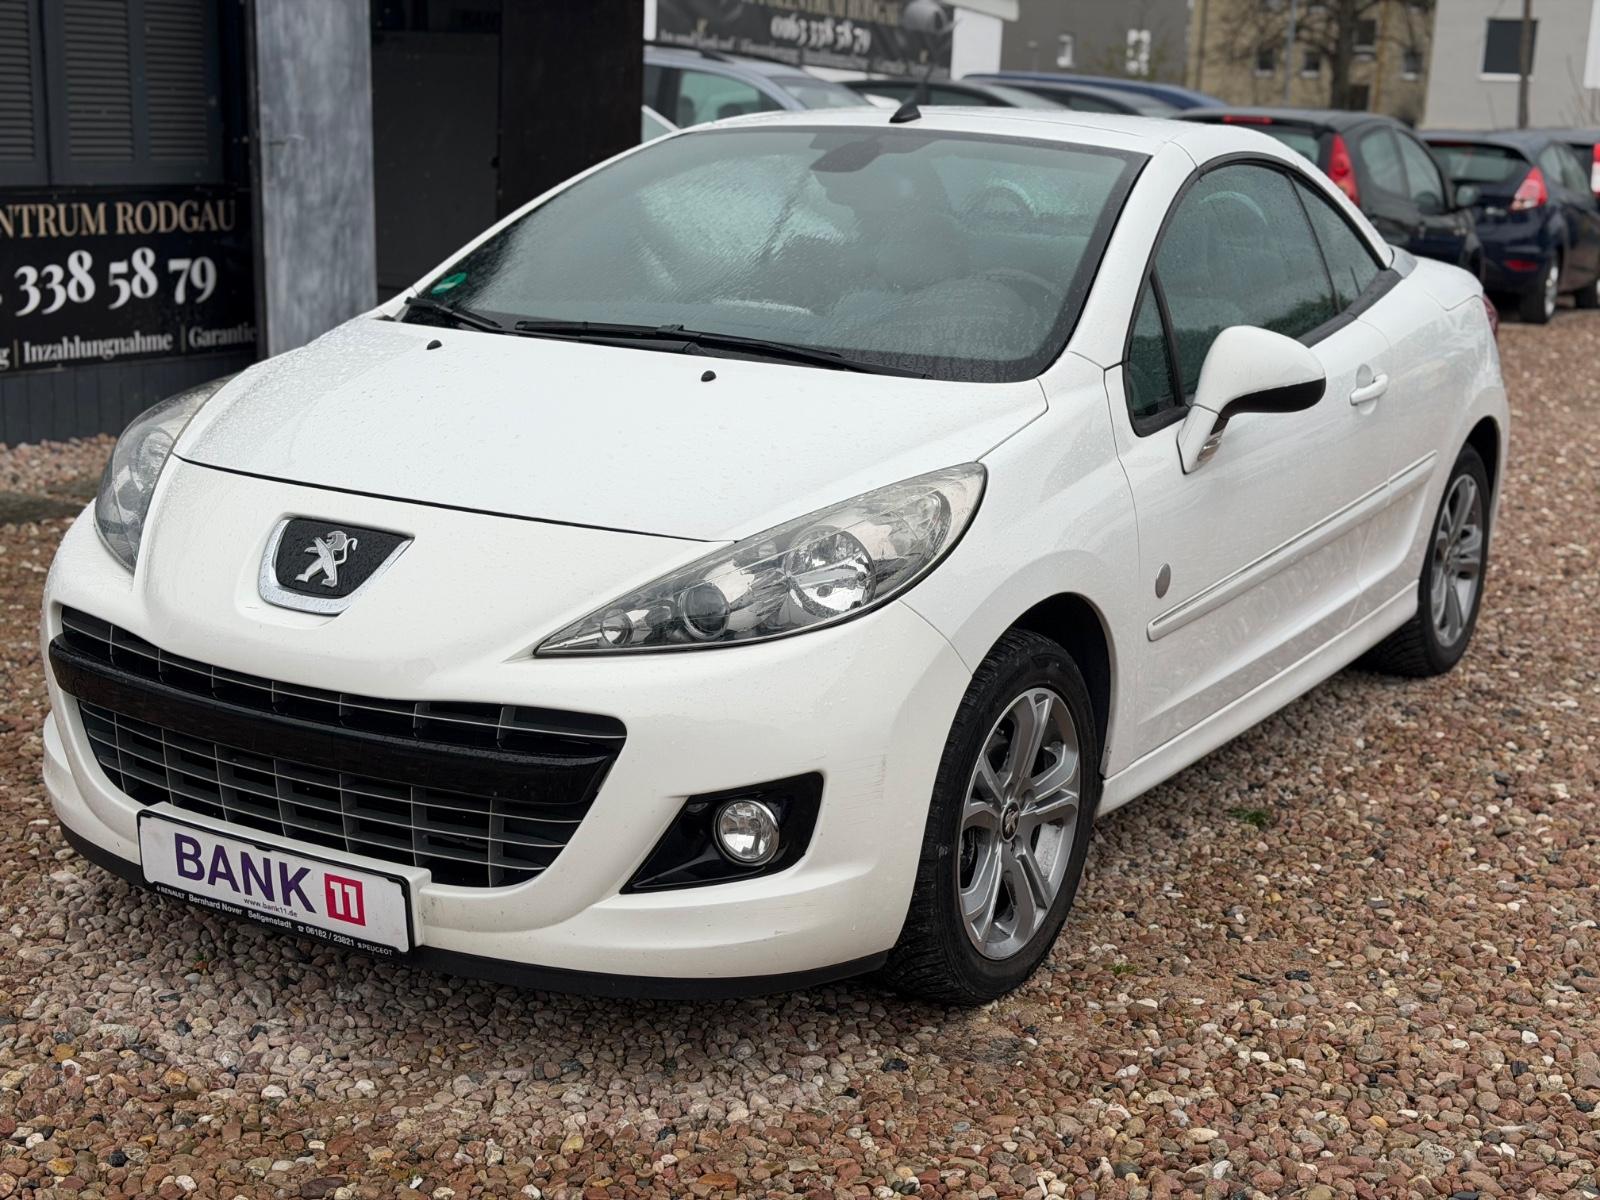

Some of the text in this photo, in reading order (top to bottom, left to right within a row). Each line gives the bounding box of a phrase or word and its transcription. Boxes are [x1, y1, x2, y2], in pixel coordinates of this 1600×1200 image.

[116, 199, 236, 234] RODGAU
[14, 247, 217, 317] 338 58 79
[23, 330, 173, 364] Inzahlungnahme
[174, 832, 361, 922] BANK 11
[188, 894, 220, 910] Bernhard
[243, 898, 298, 918] www.bank11.de
